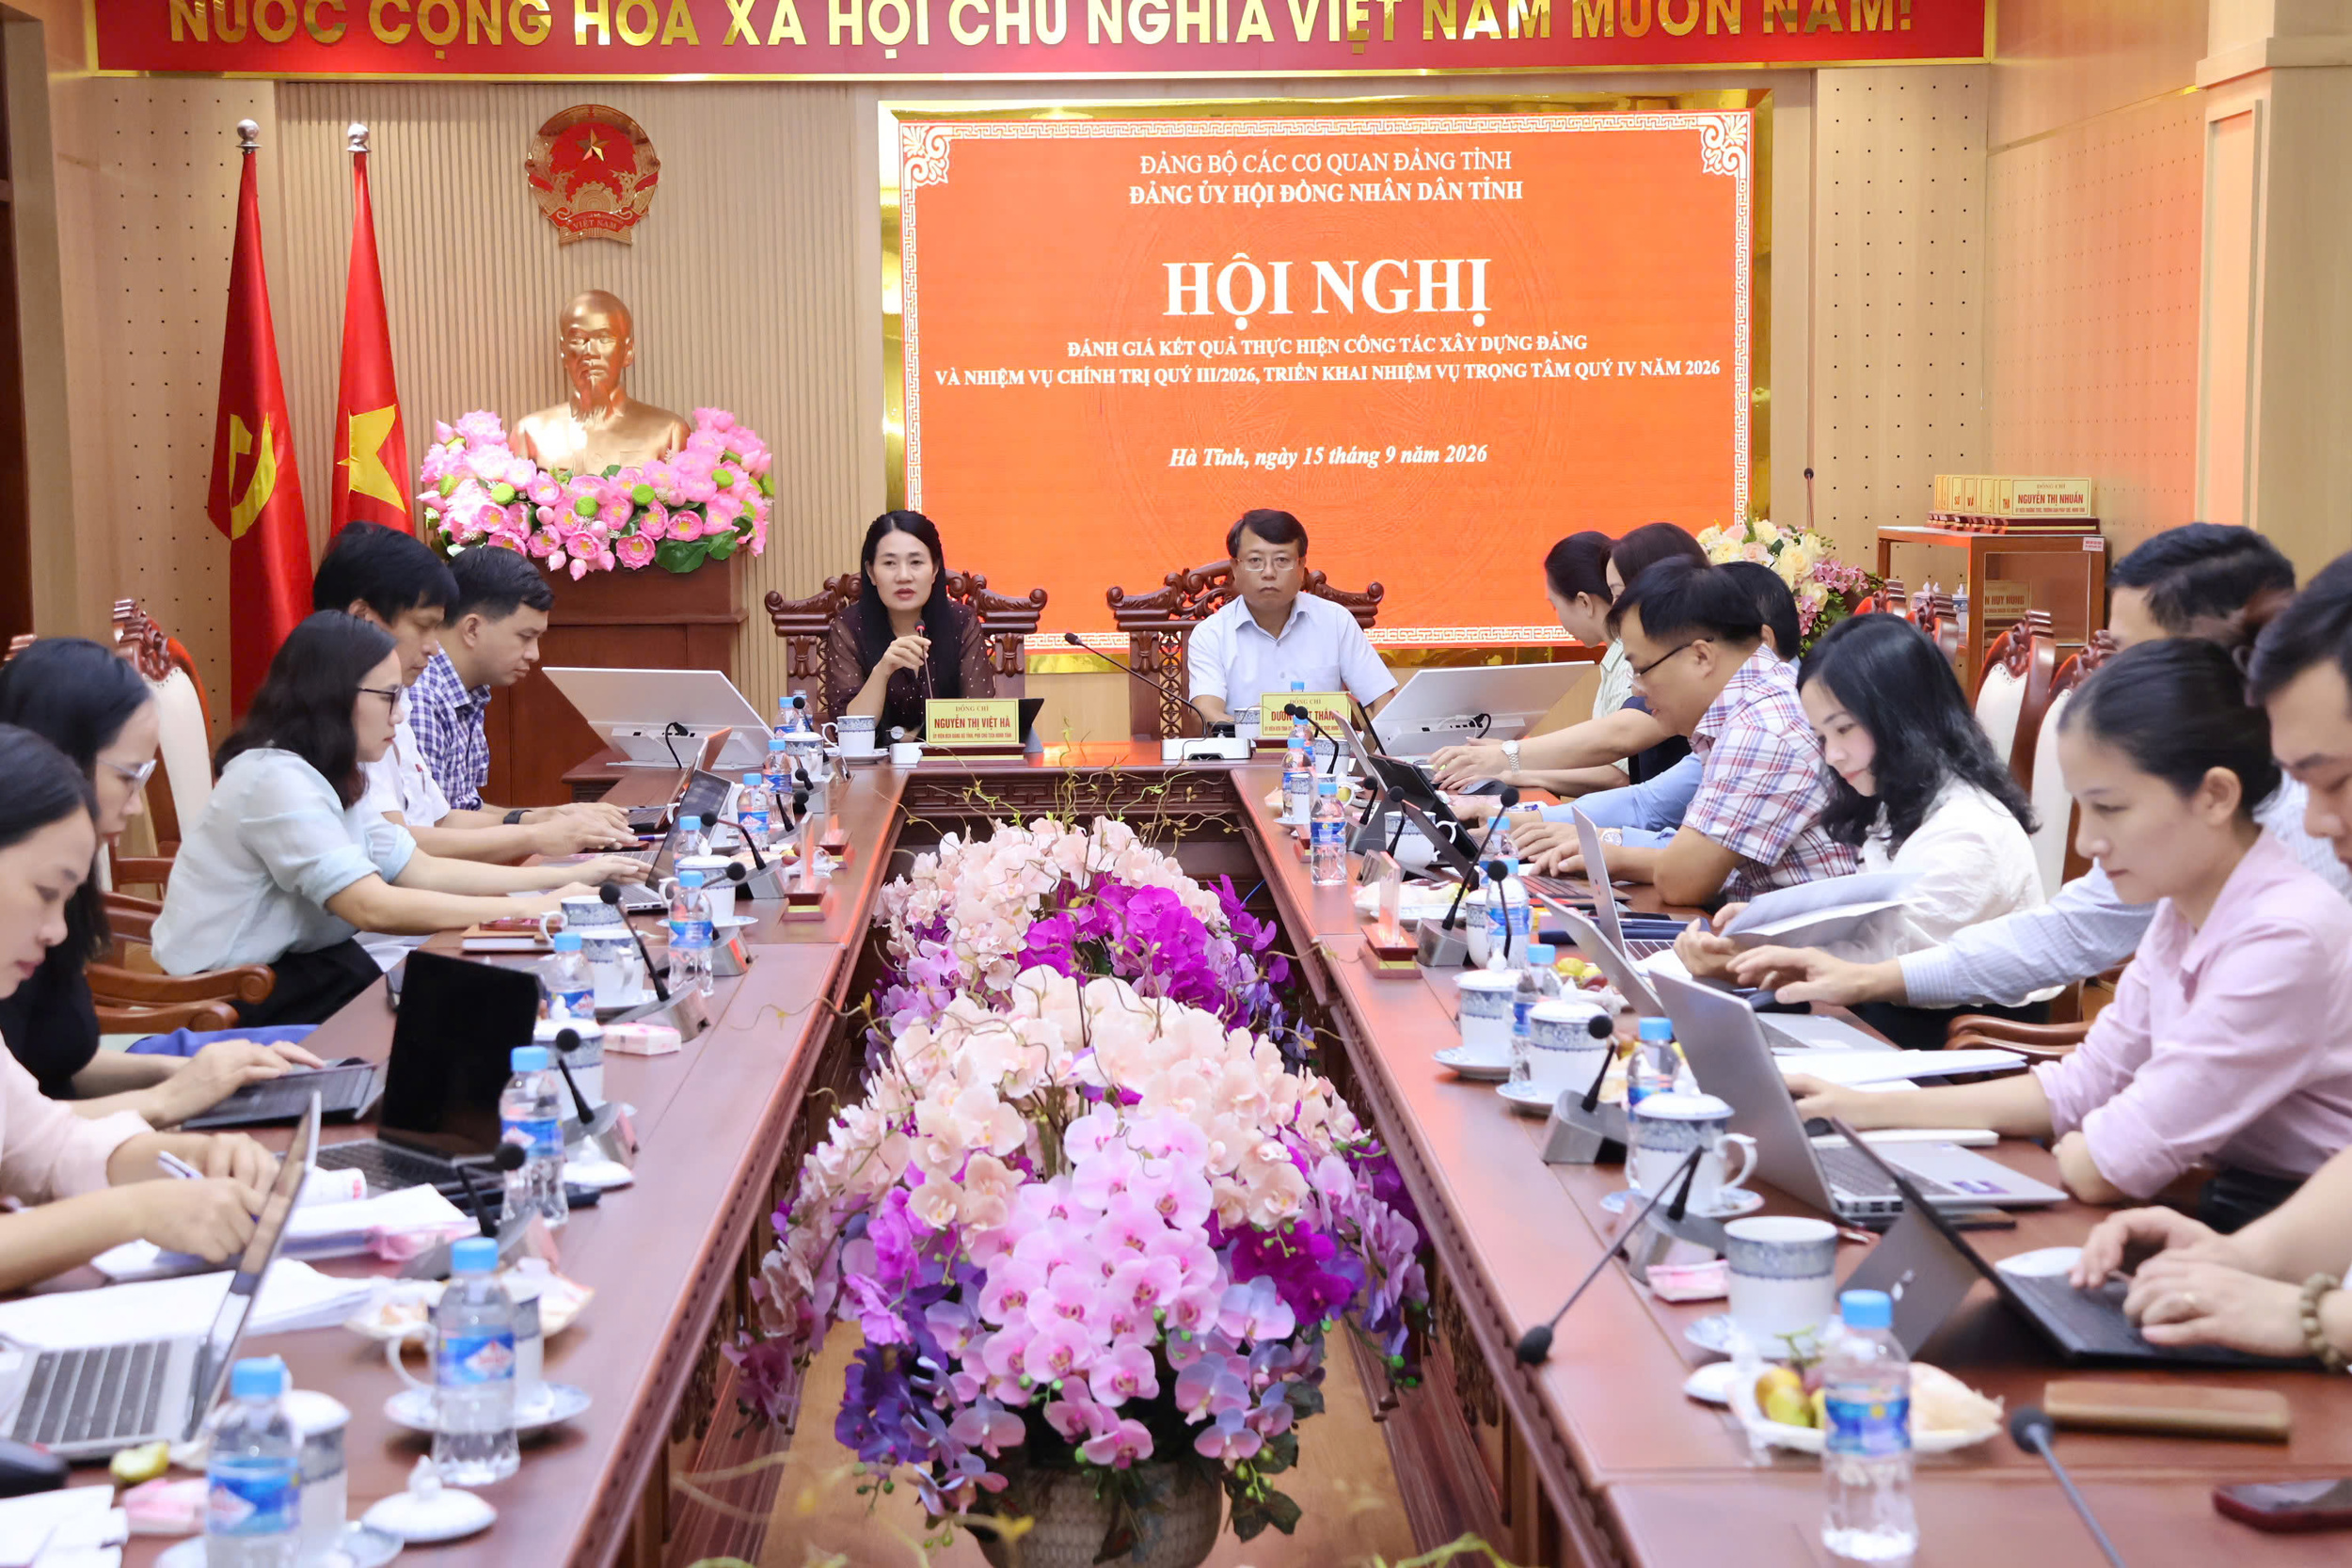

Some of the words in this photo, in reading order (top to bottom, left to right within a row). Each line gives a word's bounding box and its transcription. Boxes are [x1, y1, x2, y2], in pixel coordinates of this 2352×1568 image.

[1422, 0, 1551, 40] NAM
[1139, 150, 1203, 175] ĐẢNG
[1207, 150, 1238, 177] BỘ
[1242, 149, 1287, 173] CÁC
[1291, 152, 1322, 172] CƠ
[1326, 152, 1389, 177] QUAN
[1393, 147, 1456, 171] ĐẢNG
[1460, 146, 1512, 170] TỈNH
[1129, 180, 1193, 205] ĐẢNG
[1198, 180, 1230, 204] ỦY
[1232, 182, 1275, 209] HỘI
[1279, 178, 1344, 203] ĐỒNG
[1348, 177, 1412, 202] NHÂN
[1417, 176, 1464, 201] DÂN
[1468, 176, 1524, 200] TỈNH
[1162, 252, 1295, 331] HỘI
[1311, 258, 1492, 327] NGHỊ
[1067, 338, 1120, 357] ĐÁNH
[1121, 337, 1155, 356] GIÁ
[1158, 336, 1197, 356] KẾT
[1198, 335, 1238, 359] QUẢ
[1240, 337, 1293, 358] THỰC
[1295, 336, 1341, 357] HIỆN
[1343, 334, 1396, 354] CÔNG
[1398, 334, 1437, 353] TÁC
[1439, 332, 1478, 353] XÂY
[1480, 333, 1534, 355] DỰNG
[1535, 330, 1588, 351] ĐẢNG
[934, 367, 961, 386] VÀ
[963, 367, 1025, 388] NHIỆM
[1027, 369, 1054, 388] VỤ
[1057, 365, 1116, 385] CHÍNH
[1119, 368, 1151, 388] TRỊ
[1153, 364, 1193, 387] QUÝ
[1196, 367, 1261, 385] III/2026,
[1263, 361, 1318, 382] TRIỂN
[1322, 365, 1368, 381] KHAI
[1372, 362, 1432, 384] NHIỆM
[1435, 364, 1461, 383] VỤ
[1463, 363, 1528, 382] TRỌNG
[1530, 358, 1571, 378] TÂM
[1574, 357, 1613, 381] QUÝ
[1617, 361, 1637, 377] IV
[1640, 357, 1682, 376] NĂM
[1685, 359, 1721, 375] 2026
[1168, 448, 1198, 467] Hà
[1203, 447, 1249, 469] Tĩnh,
[1254, 447, 1298, 470] ngày
[1302, 446, 1325, 466] 15
[1327, 445, 1381, 469] tháng
[1384, 445, 1397, 464] 9
[1400, 445, 1440, 464] năm
[1444, 444, 1488, 464] 2026
[2017, 490, 2045, 504] NGUYỄN
[2047, 494, 2058, 506] THỊ
[934, 714, 966, 729] NGUYỄN
[967, 718, 979, 730] THỊ
[981, 715, 998, 731] VIỆT
[999, 715, 1011, 728] HÀ
